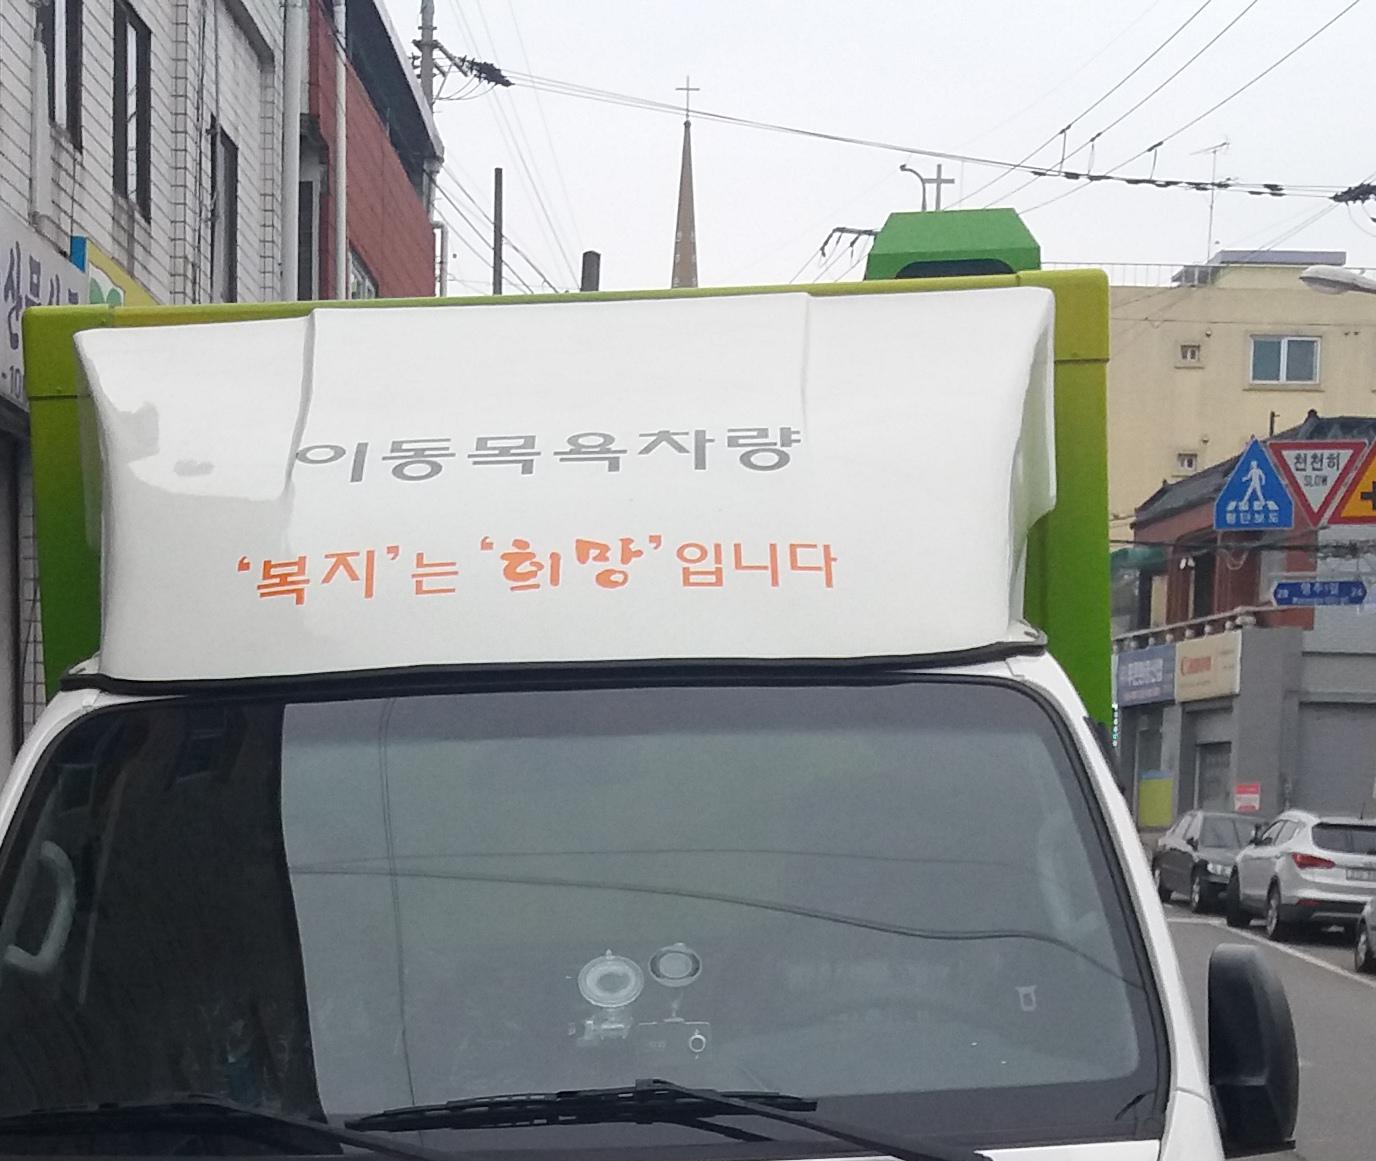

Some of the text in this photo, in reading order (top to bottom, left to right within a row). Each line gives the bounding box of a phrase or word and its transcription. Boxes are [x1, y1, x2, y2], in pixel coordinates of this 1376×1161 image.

[293, 426, 805, 484] 이동목욕차량
[1293, 451, 1341, 472] 천천히
[1303, 474, 1328, 487] SLOW
